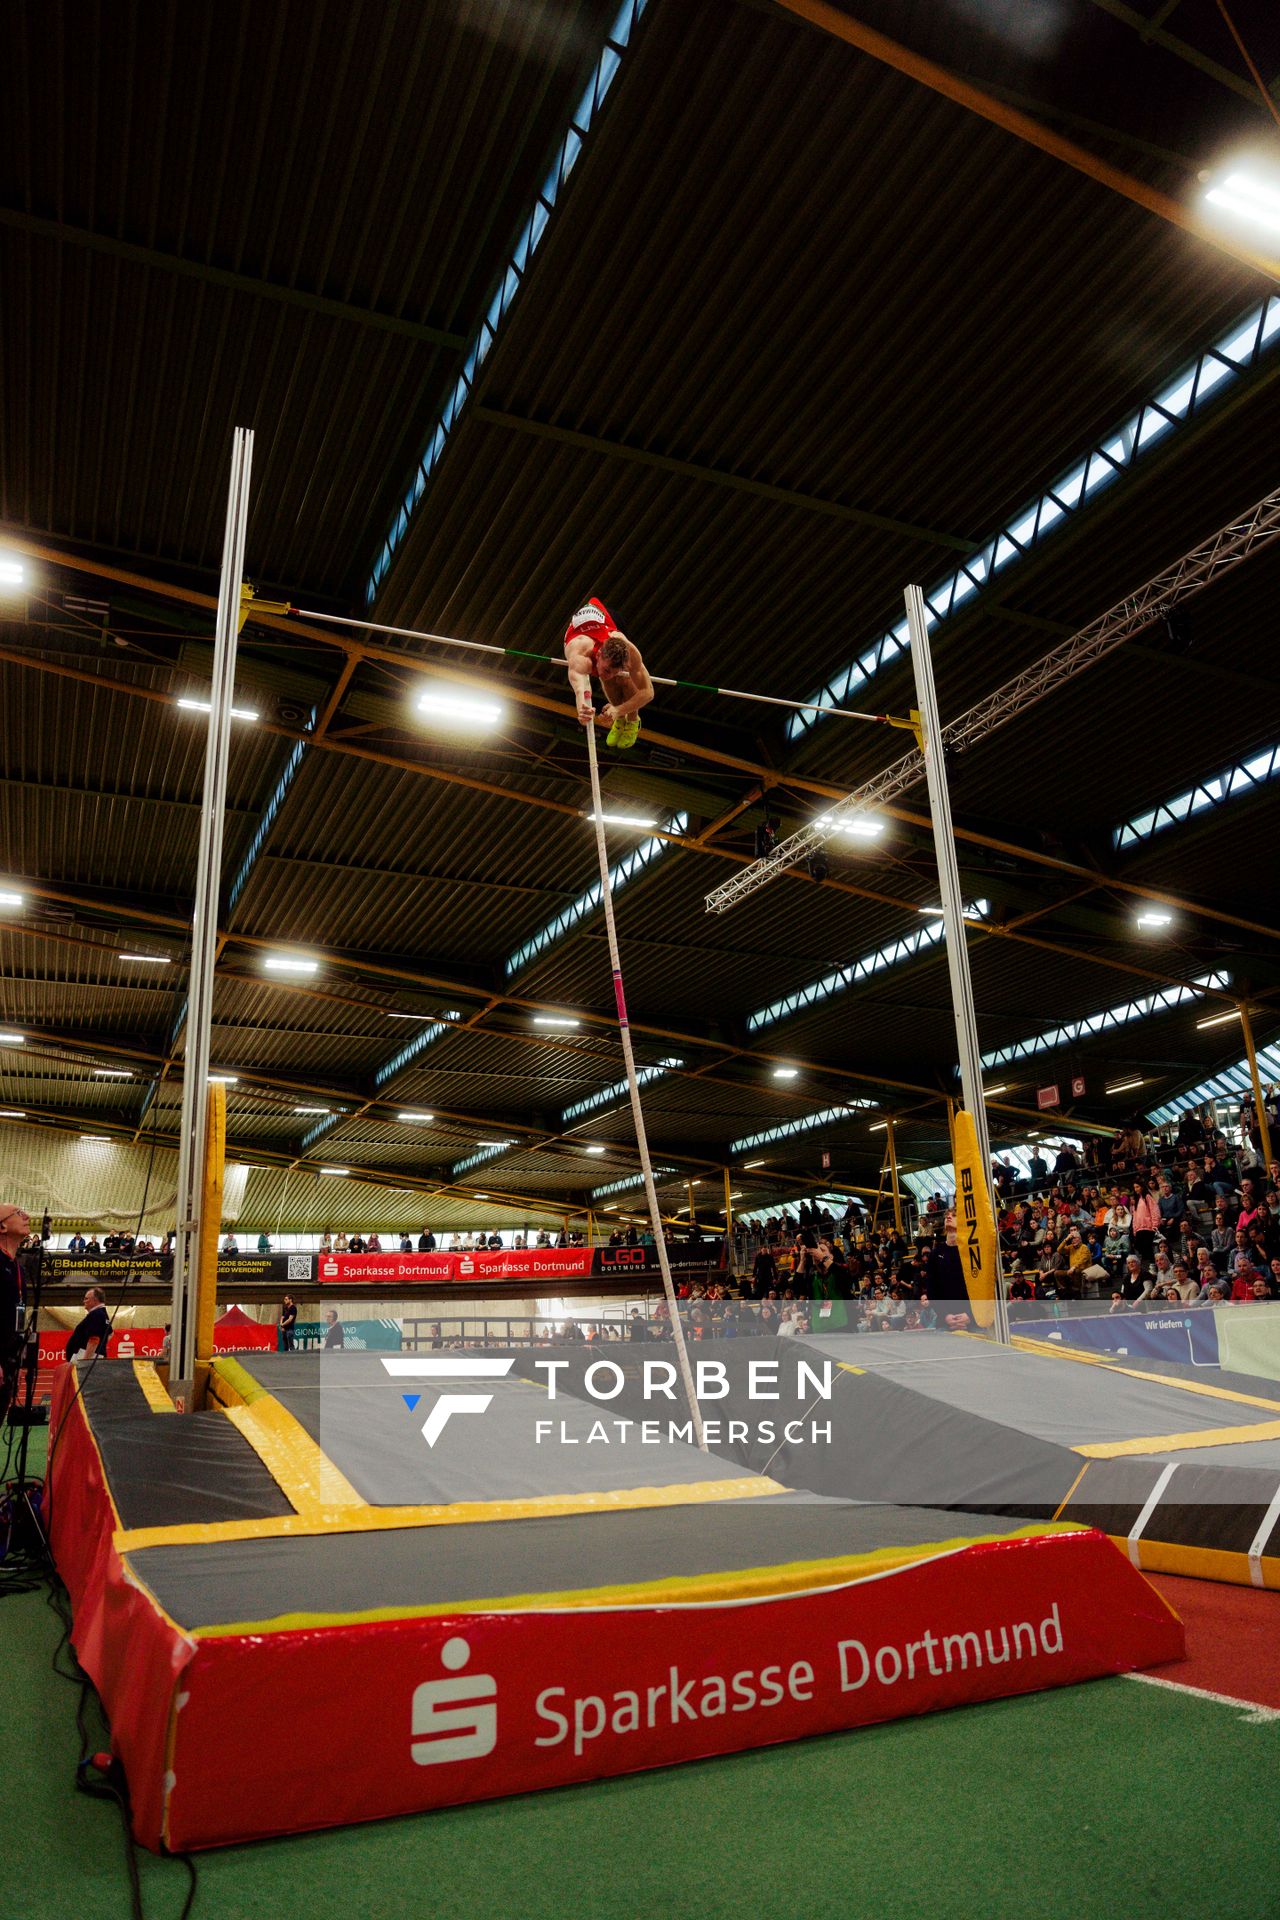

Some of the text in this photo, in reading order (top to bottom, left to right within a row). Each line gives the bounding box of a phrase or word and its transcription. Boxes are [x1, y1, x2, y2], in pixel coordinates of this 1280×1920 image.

[1073, 1080, 1084, 1093] G
[601, 1248, 645, 1265] LGO
[343, 1265, 449, 1277] Sparkasse Dortmund
[479, 1260, 585, 1275] Sparkasse Dortmund
[1144, 1319, 1183, 1330] Wir liefern
[534, 1602, 1064, 1756] Sparkasse Dortmund
